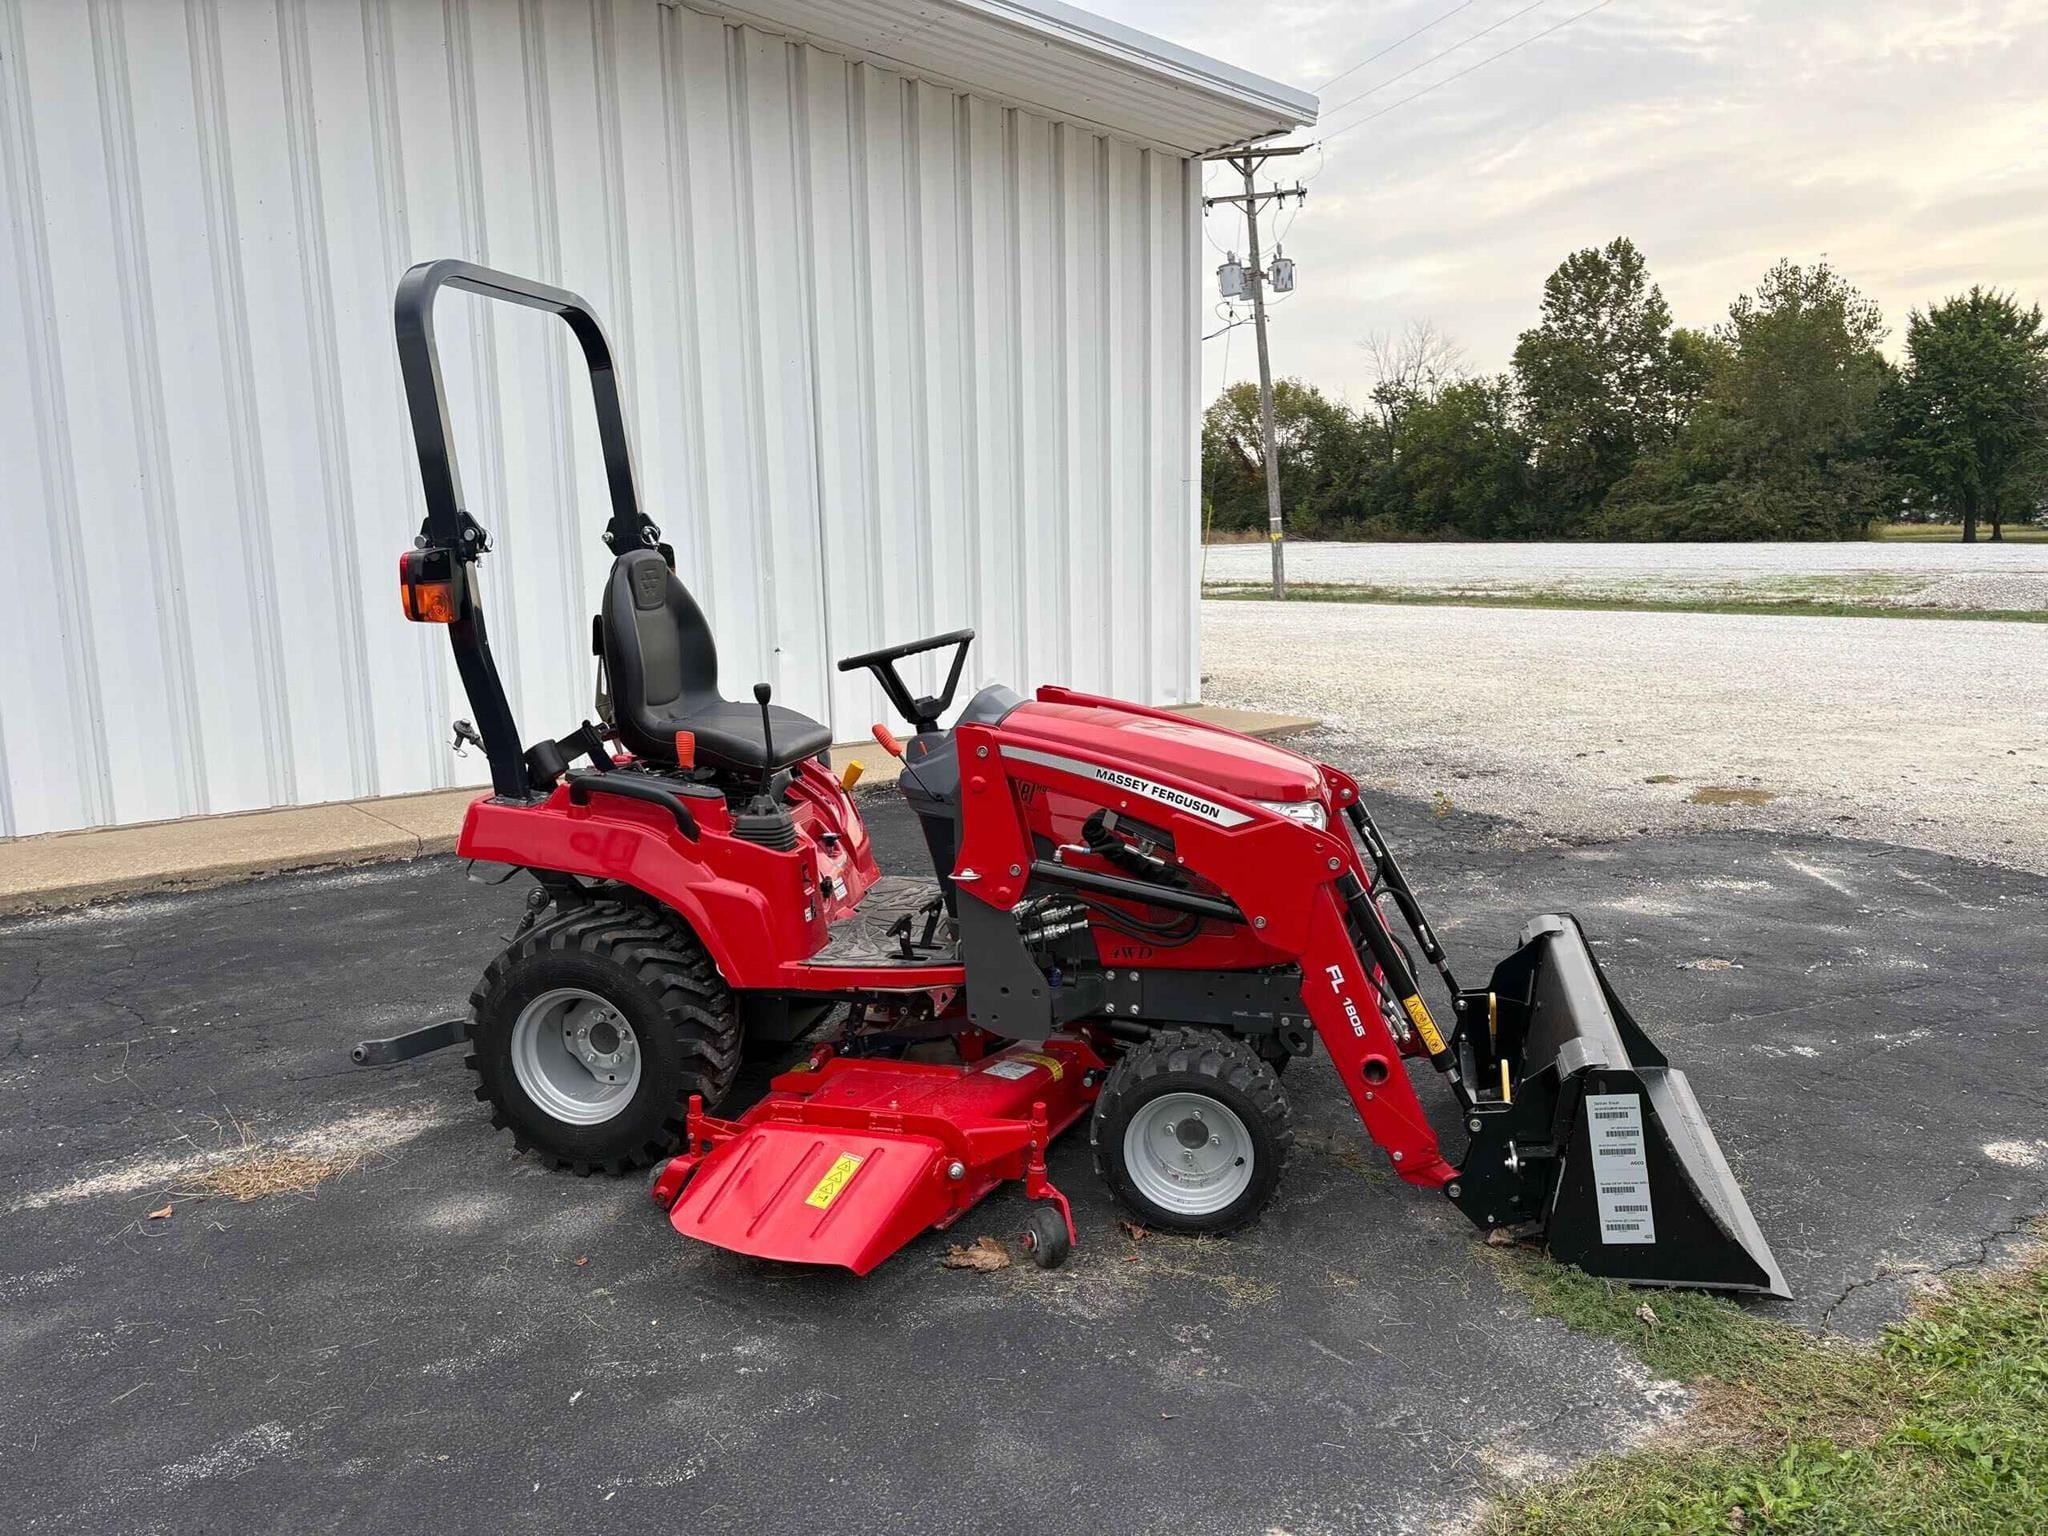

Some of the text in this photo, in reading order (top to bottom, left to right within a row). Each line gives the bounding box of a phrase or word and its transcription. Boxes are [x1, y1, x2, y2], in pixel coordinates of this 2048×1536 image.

[1096, 768, 1220, 818] MASSEY FERGUSON
[1111, 946, 1153, 961] 4WD
[1325, 964, 1366, 1038] FL 1805
